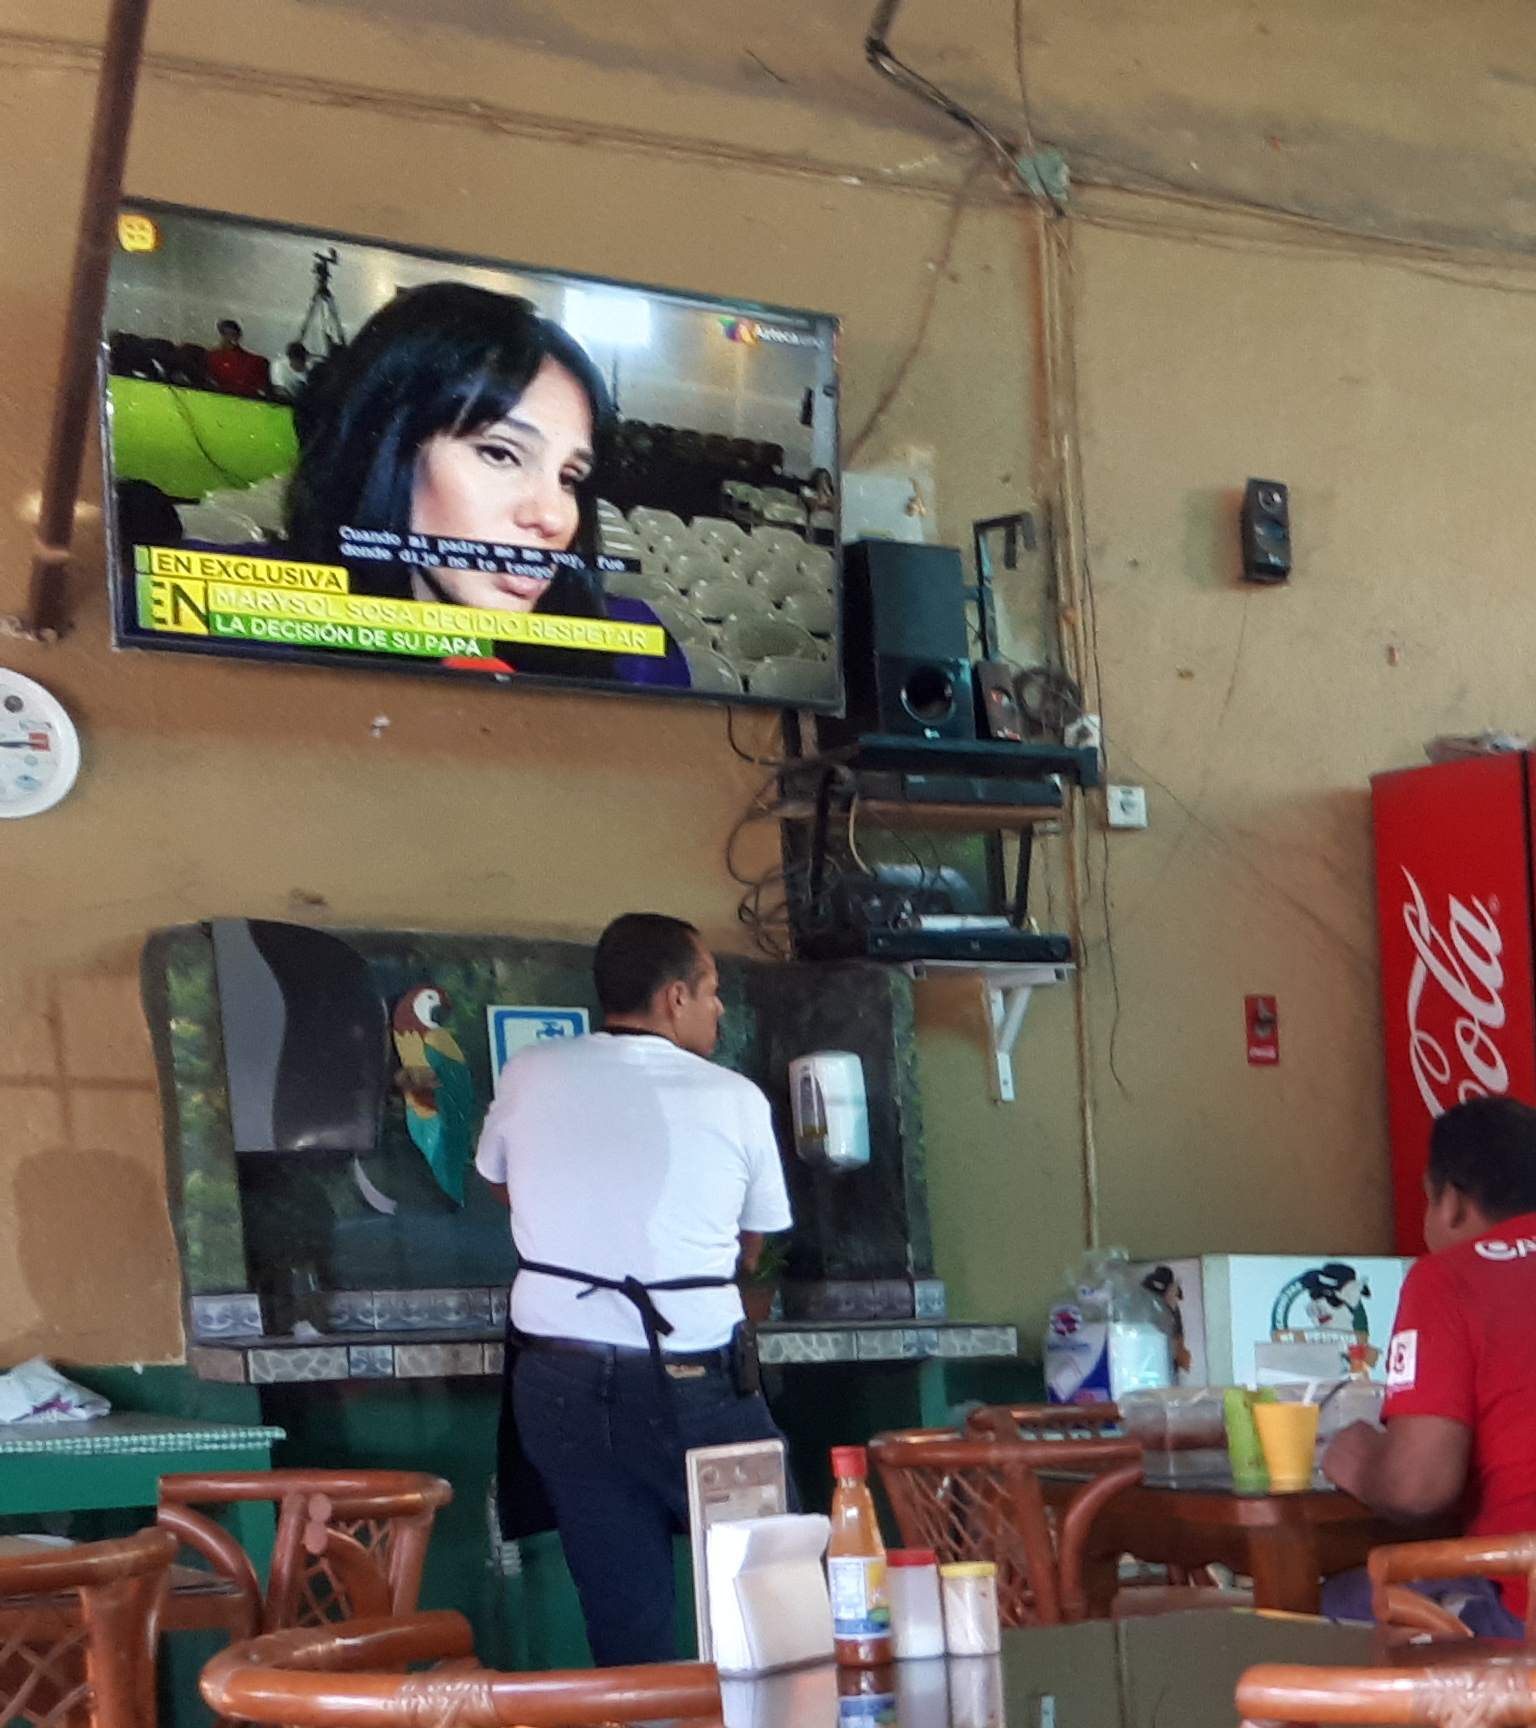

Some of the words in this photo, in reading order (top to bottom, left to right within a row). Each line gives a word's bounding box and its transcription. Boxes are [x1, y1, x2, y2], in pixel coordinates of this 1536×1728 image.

[339, 525, 401, 546] Cuando
[156, 553, 192, 574] EN
[200, 558, 344, 592] EXCLUSIVA
[152, 581, 209, 632] EN
[215, 587, 341, 615] MARYSOL
[346, 600, 415, 626] SOSA
[527, 619, 648, 648] RESPETAR
[215, 616, 246, 636] LA
[250, 616, 354, 645] DECISIÓN
[358, 627, 388, 647] DE
[391, 632, 419, 649] SU
